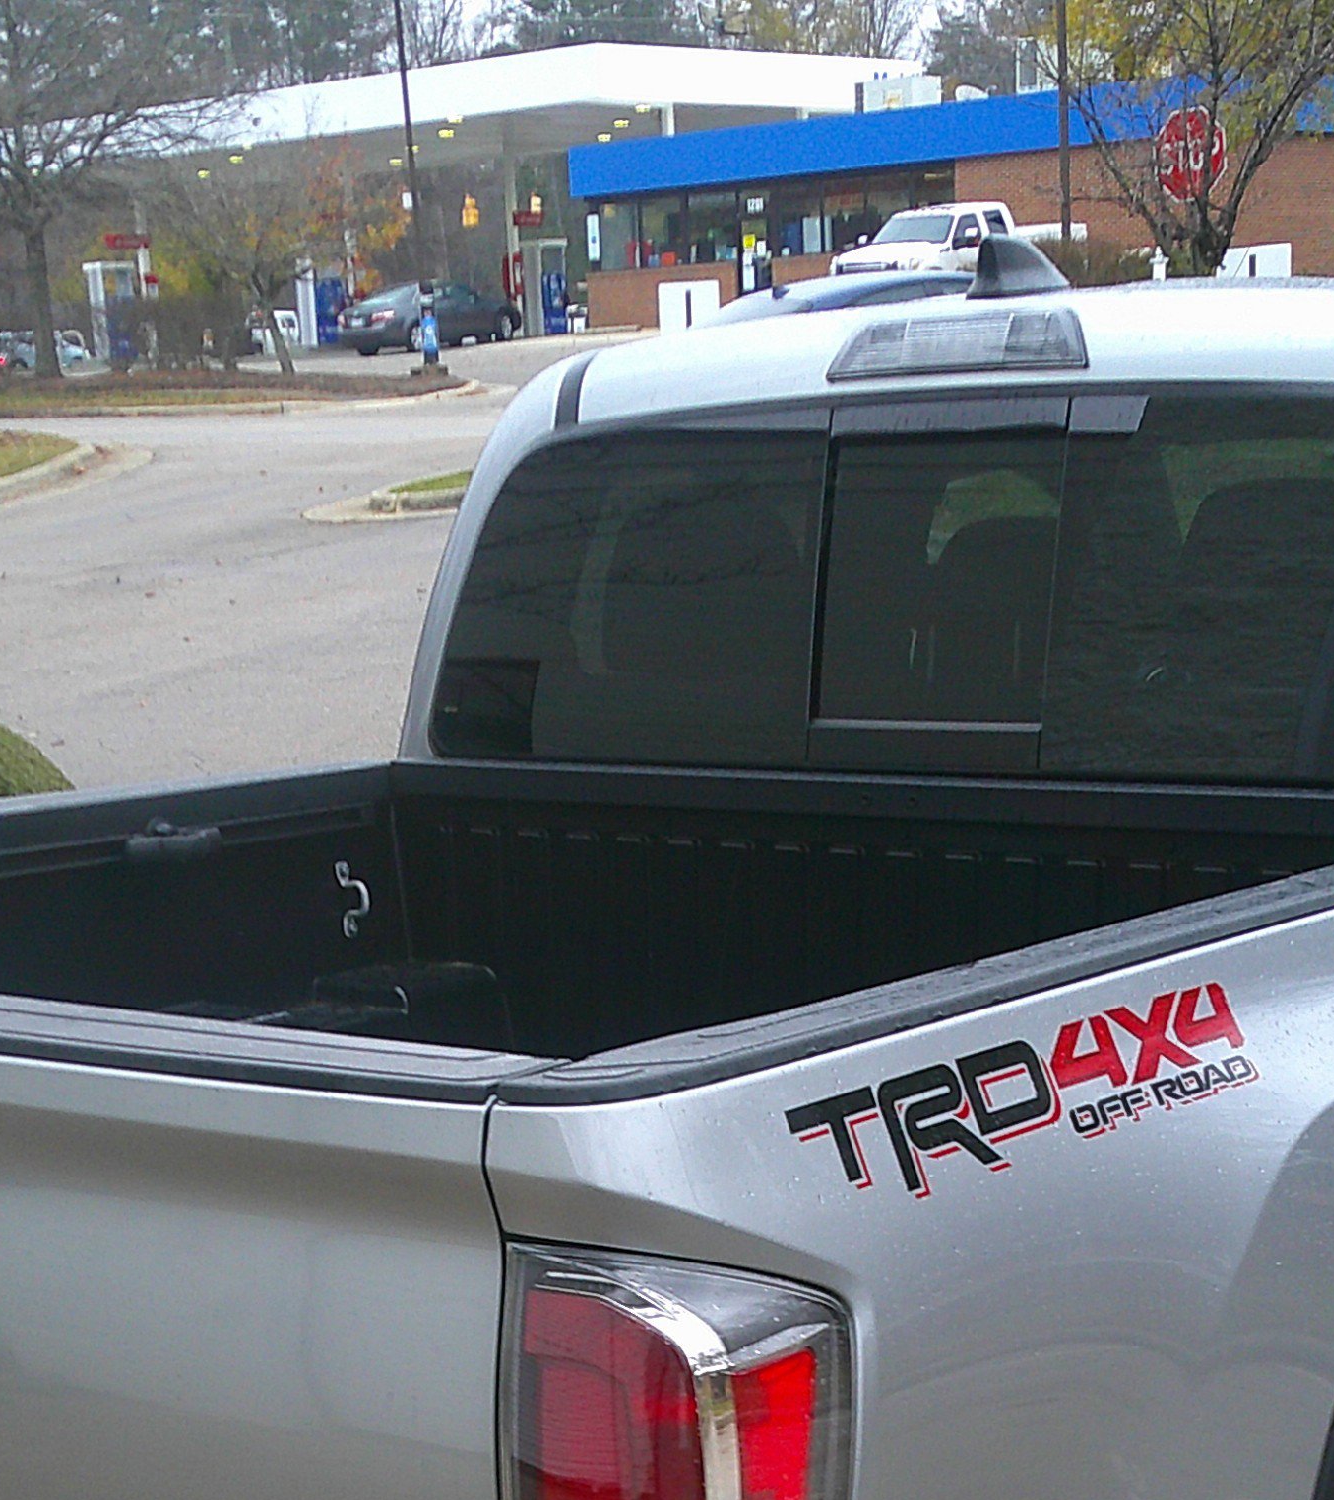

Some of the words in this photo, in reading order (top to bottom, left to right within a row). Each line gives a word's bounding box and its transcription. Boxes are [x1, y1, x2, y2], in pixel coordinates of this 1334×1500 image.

[1160, 137, 1220, 175] STOP
[784, 1039, 1061, 1198] TRD
[1049, 981, 1246, 1091] 4X4
[1067, 1088, 1151, 1138] OFF
[1149, 1054, 1259, 1112] ROAD
